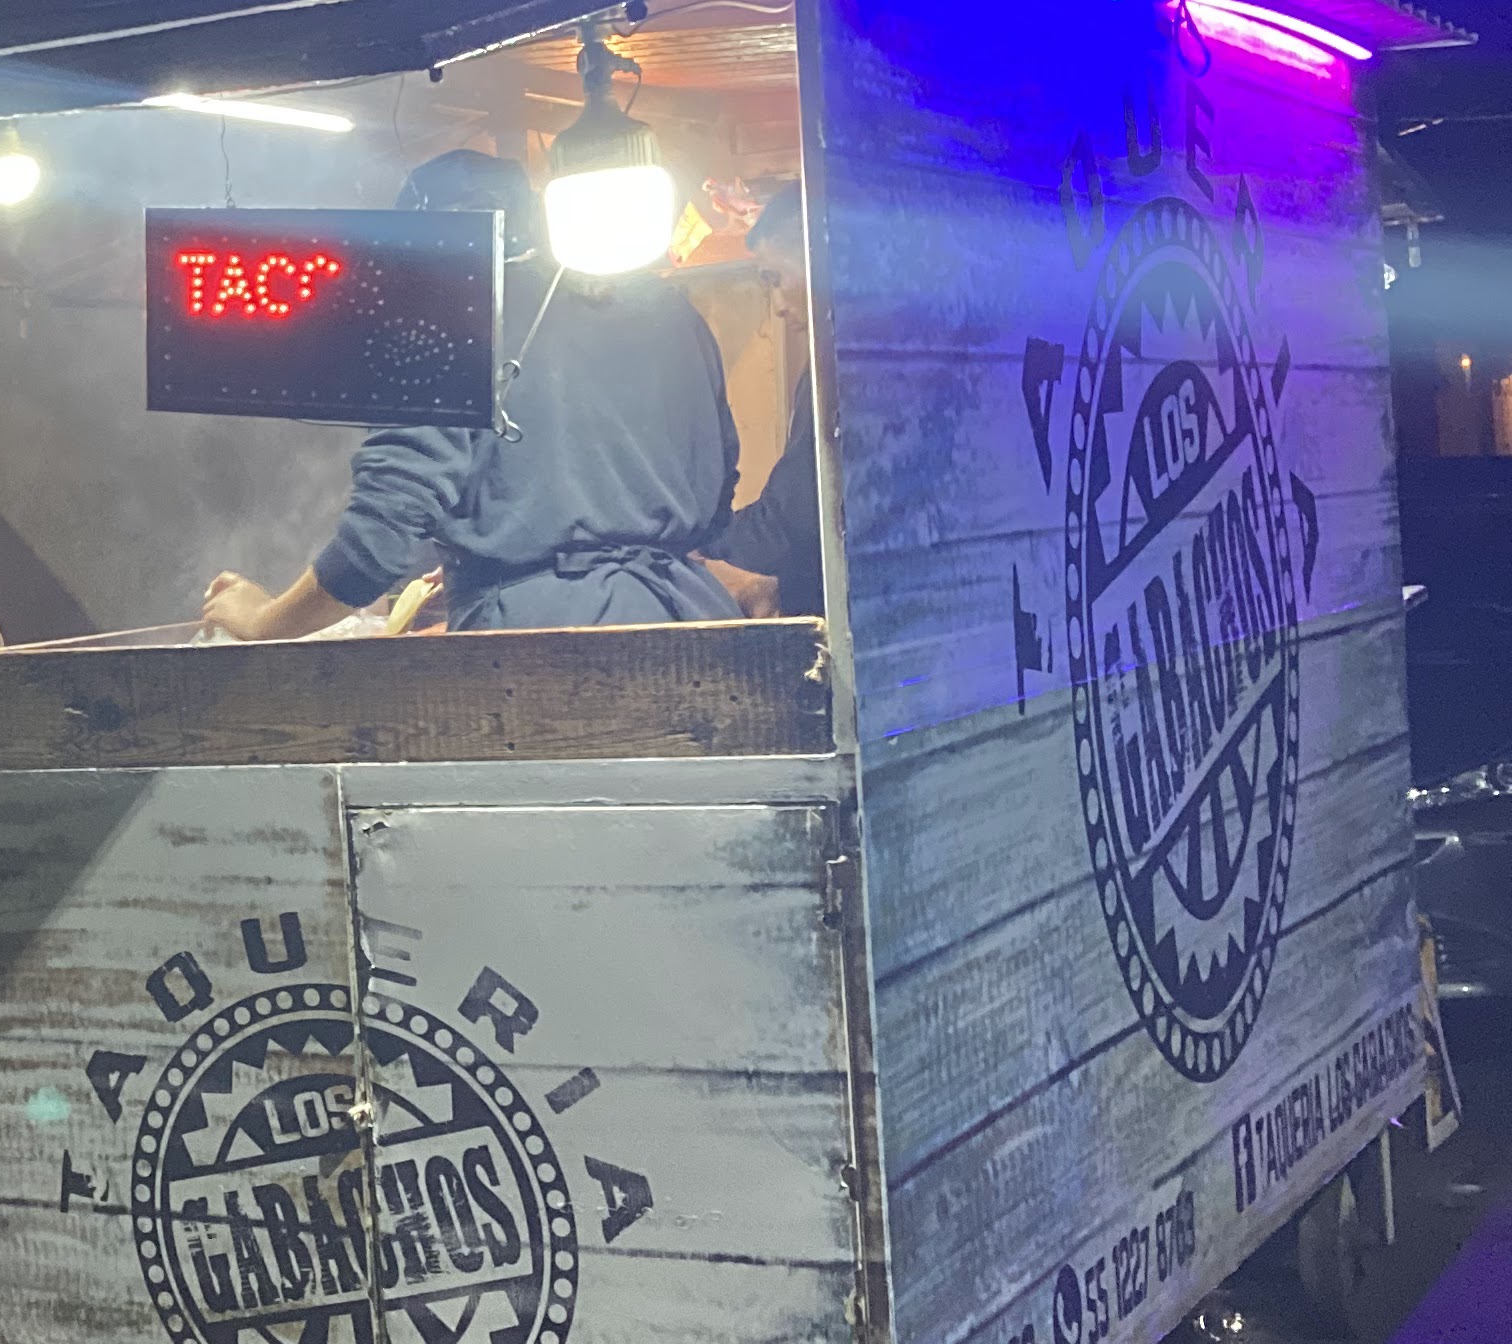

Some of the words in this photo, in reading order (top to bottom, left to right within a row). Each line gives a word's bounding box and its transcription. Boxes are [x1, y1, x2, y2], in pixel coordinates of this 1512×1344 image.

[1143, 378, 1201, 500] LOS
[59, 911, 654, 1244] TAQUERIA
[266, 1086, 356, 1145] LOS
[1255, 1073, 1326, 1191] TAQUERIA
[182, 1144, 522, 1314] GABACHOS
[1112, 1226, 1150, 1320] 1227
